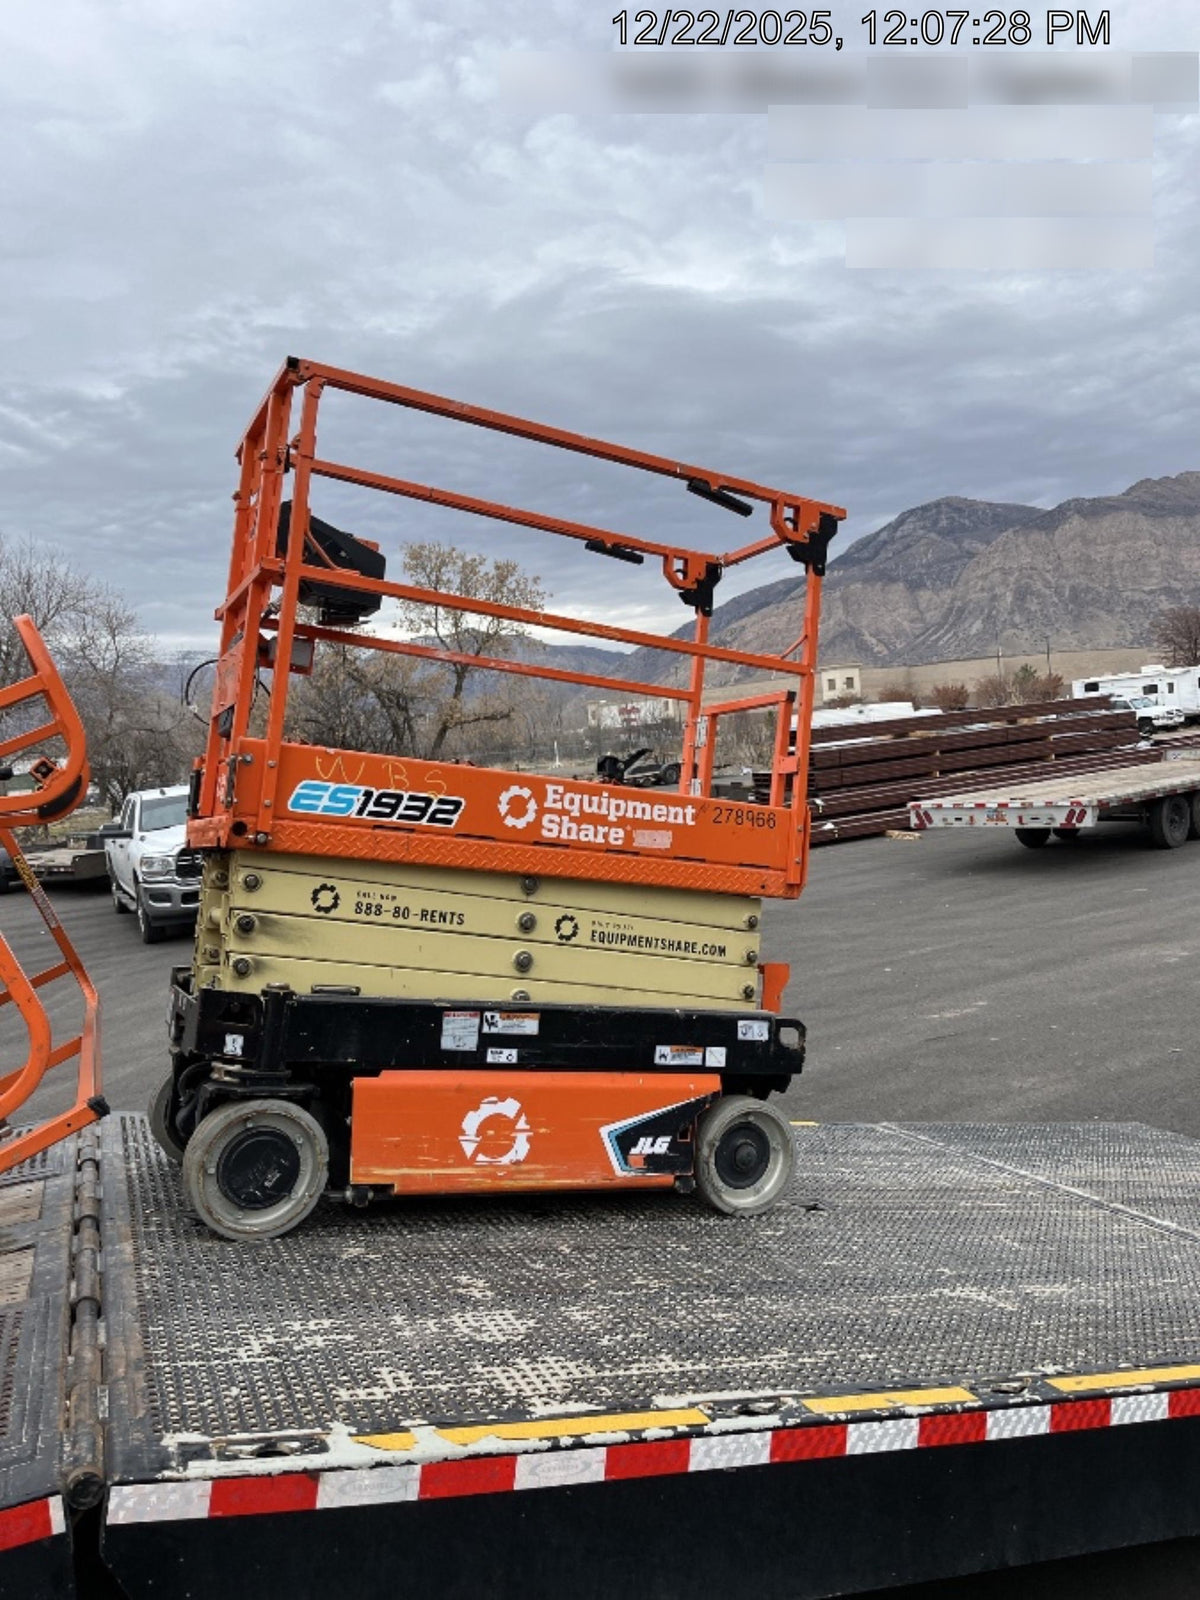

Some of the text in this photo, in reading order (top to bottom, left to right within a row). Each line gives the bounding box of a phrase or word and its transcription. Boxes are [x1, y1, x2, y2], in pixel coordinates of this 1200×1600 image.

[289, 780, 465, 827] ES1932
[543, 783, 697, 826] Equipment
[540, 813, 626, 846] Share
[711, 806, 777, 830] 278966
[354, 900, 466, 926] 888-80-RENTS
[590, 929, 727, 957] EQUIPMENTSHARE.COM
[628, 1136, 673, 1155] JLG
